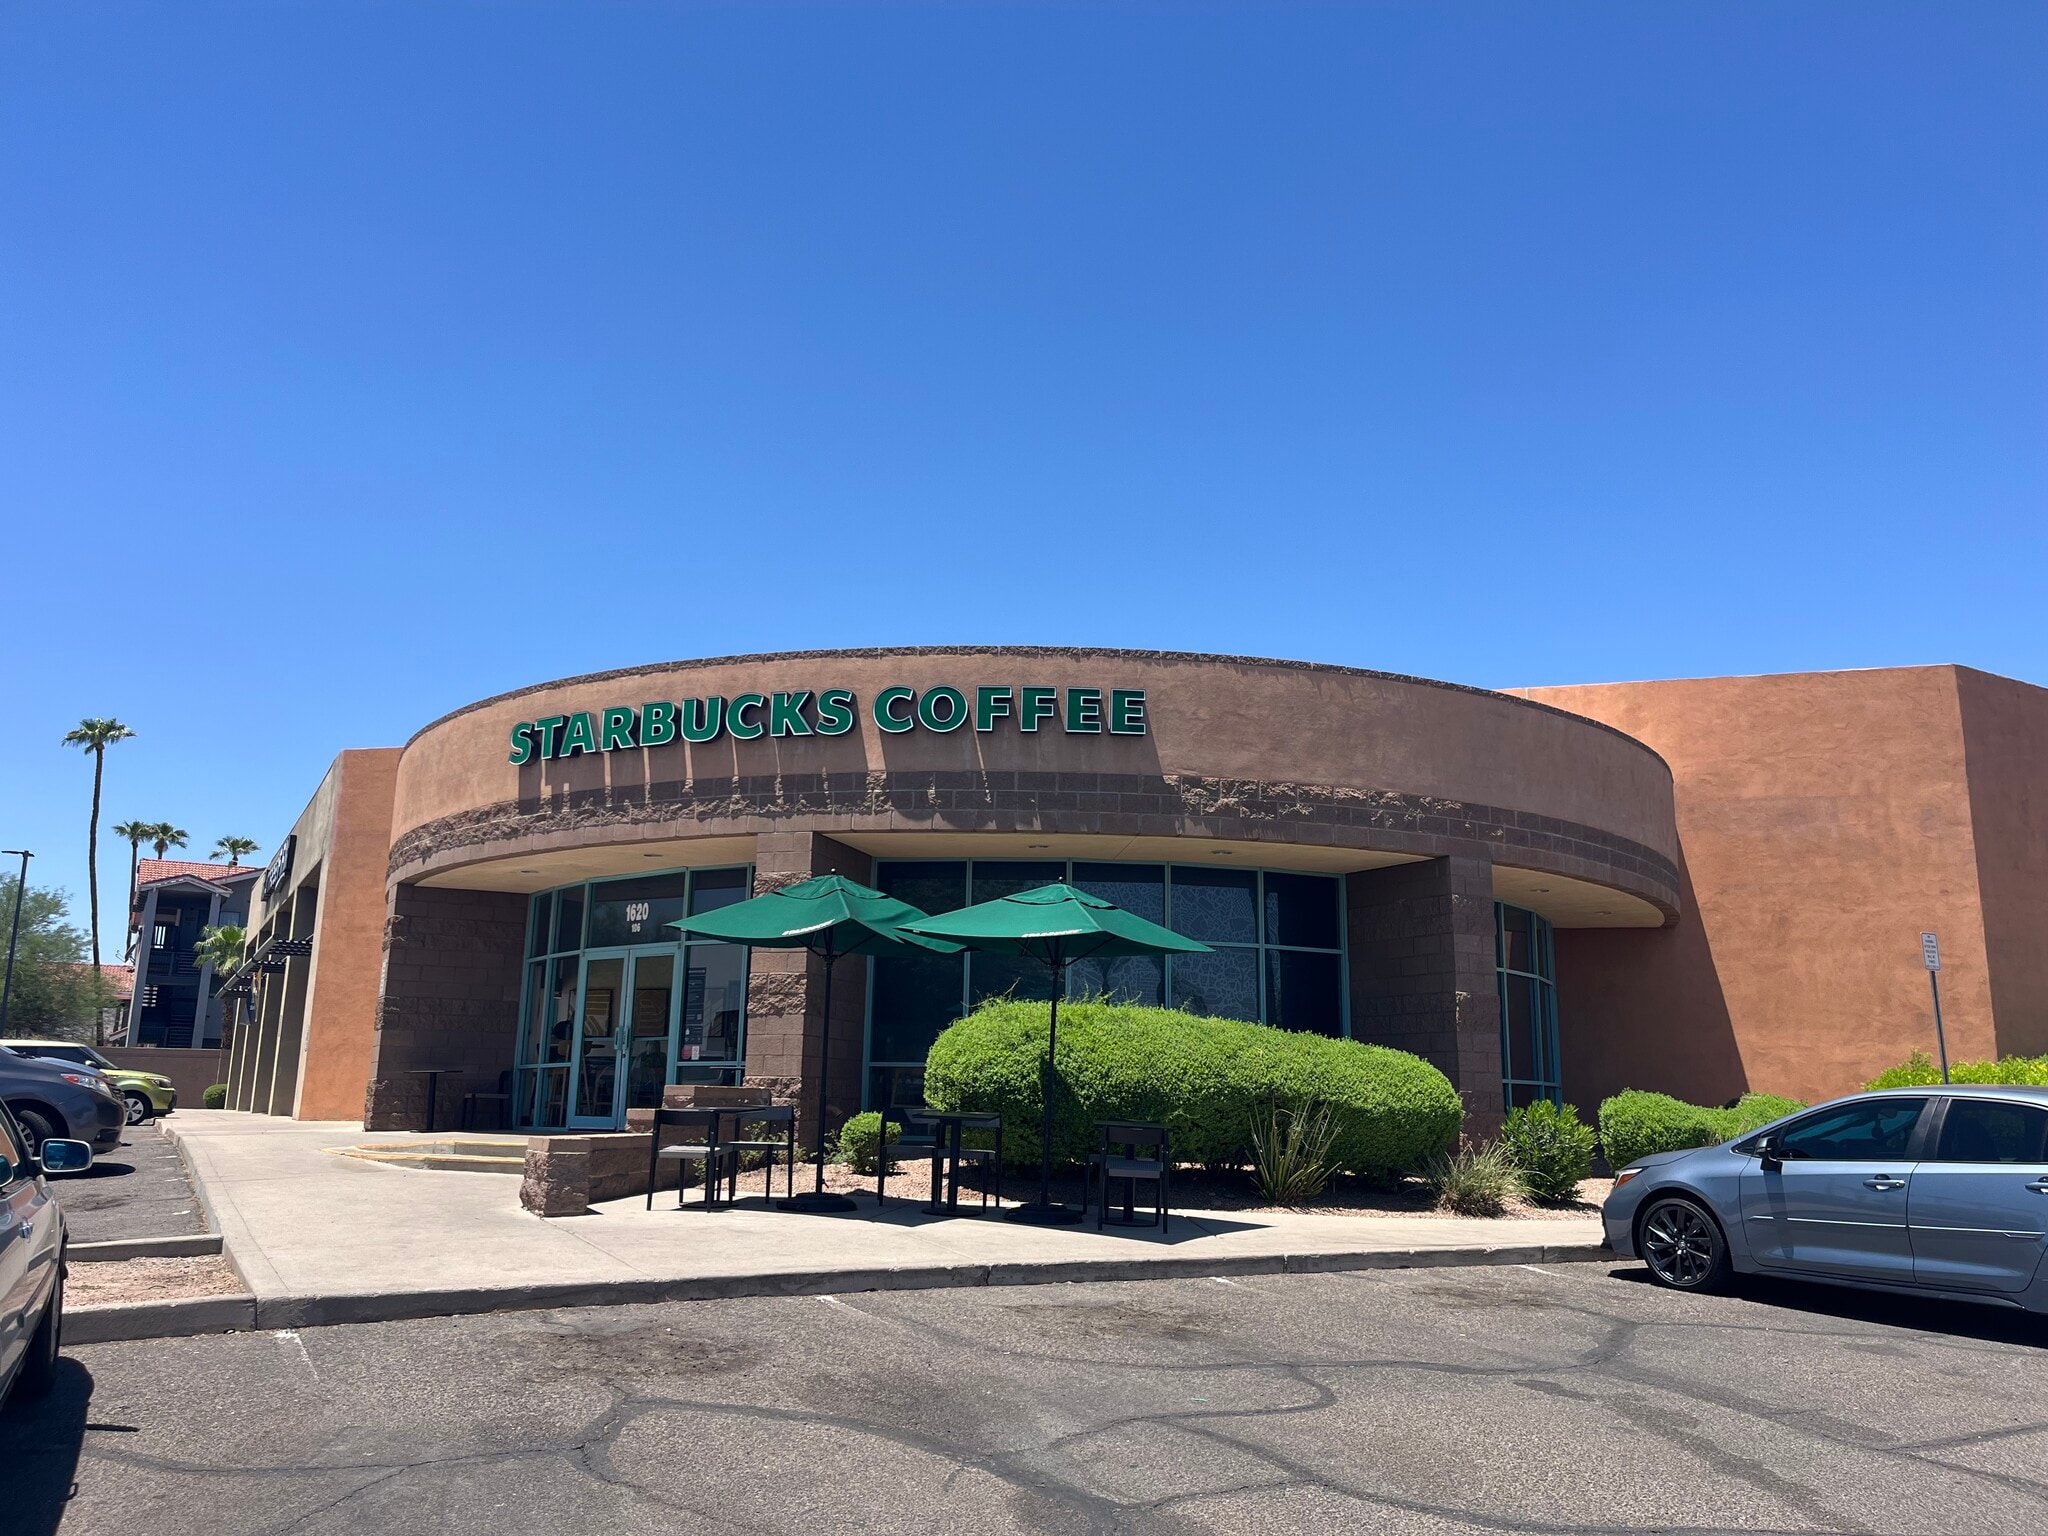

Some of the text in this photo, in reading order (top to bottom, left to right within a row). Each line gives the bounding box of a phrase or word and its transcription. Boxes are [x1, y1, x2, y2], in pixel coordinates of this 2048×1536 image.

[508, 685, 1148, 766] STARBUCKS COFFEE
[626, 902, 649, 922] 1620
